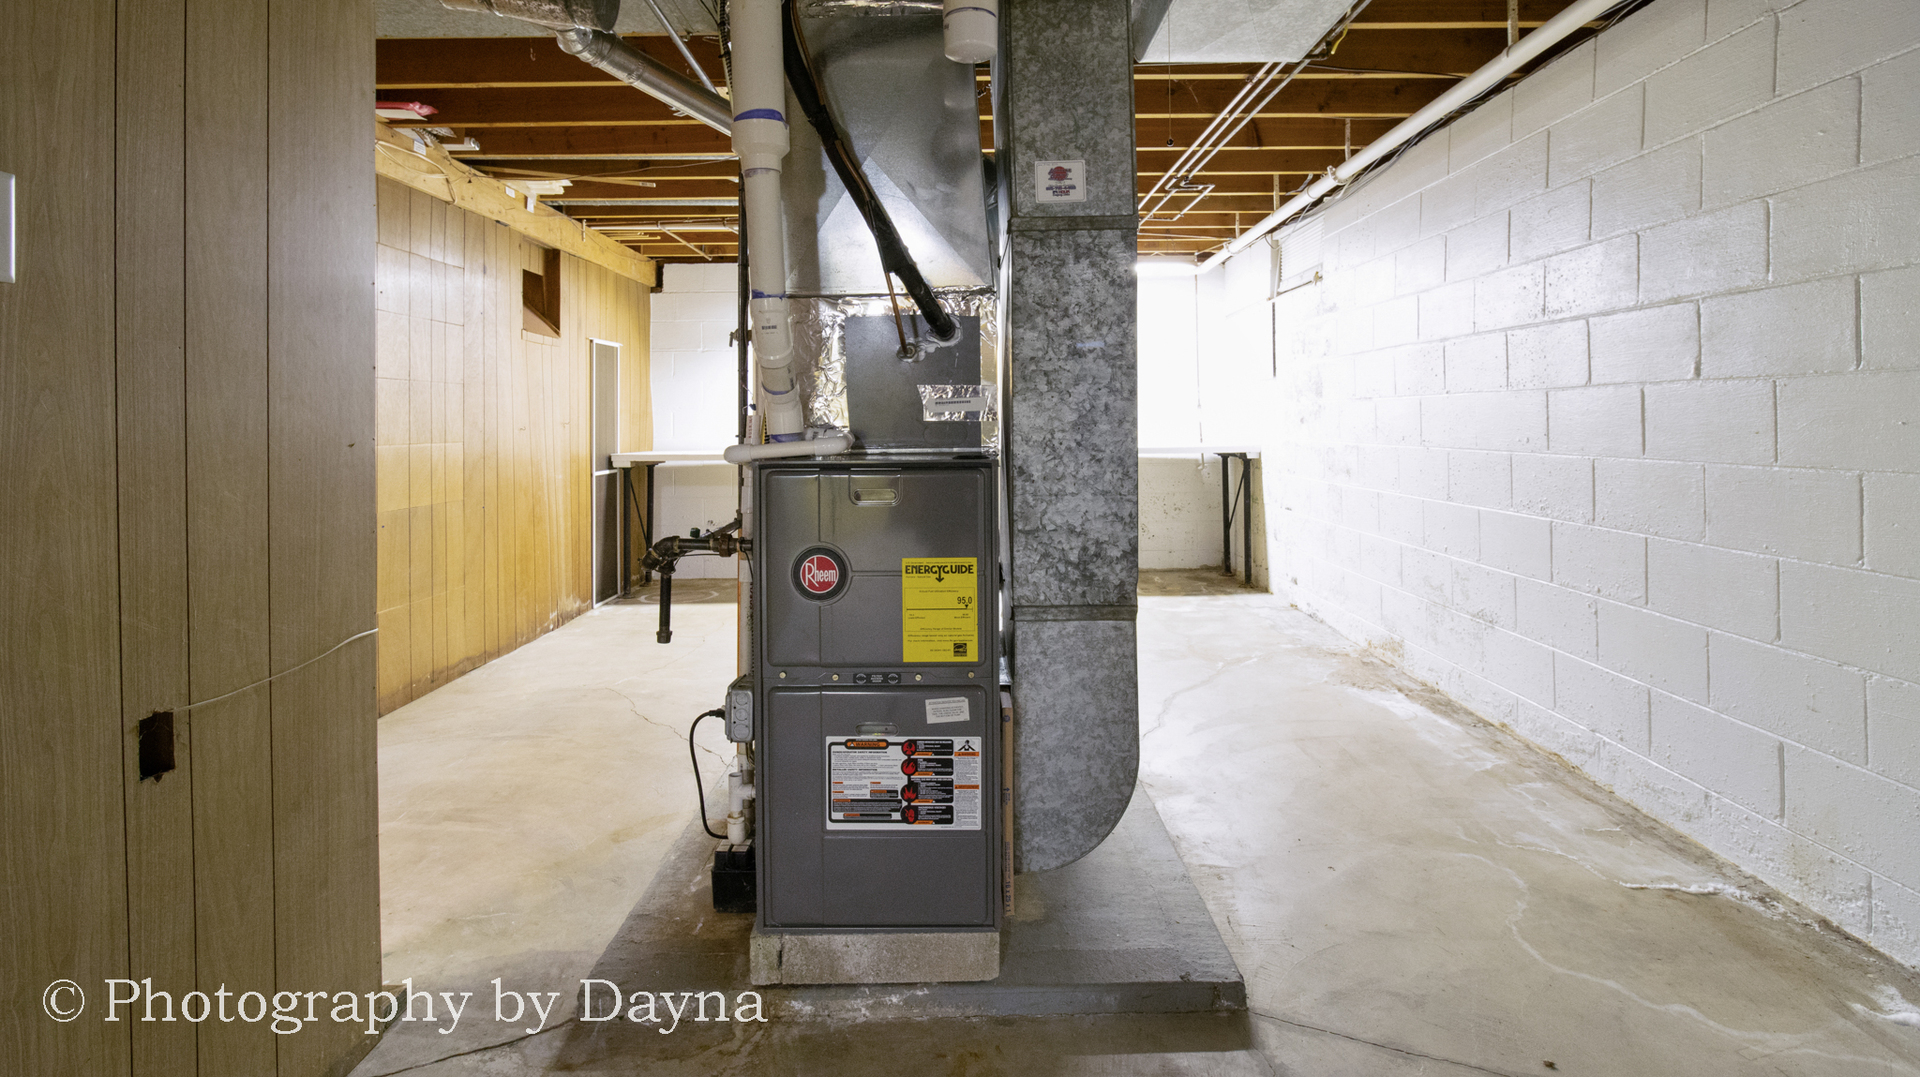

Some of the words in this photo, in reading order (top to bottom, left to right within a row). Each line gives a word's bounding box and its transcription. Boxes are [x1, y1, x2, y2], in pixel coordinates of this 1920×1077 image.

[805, 556, 836, 587] Rheem
[905, 564, 974, 575] ENERGYGUIDE
[957, 596, 972, 605] 95.0
